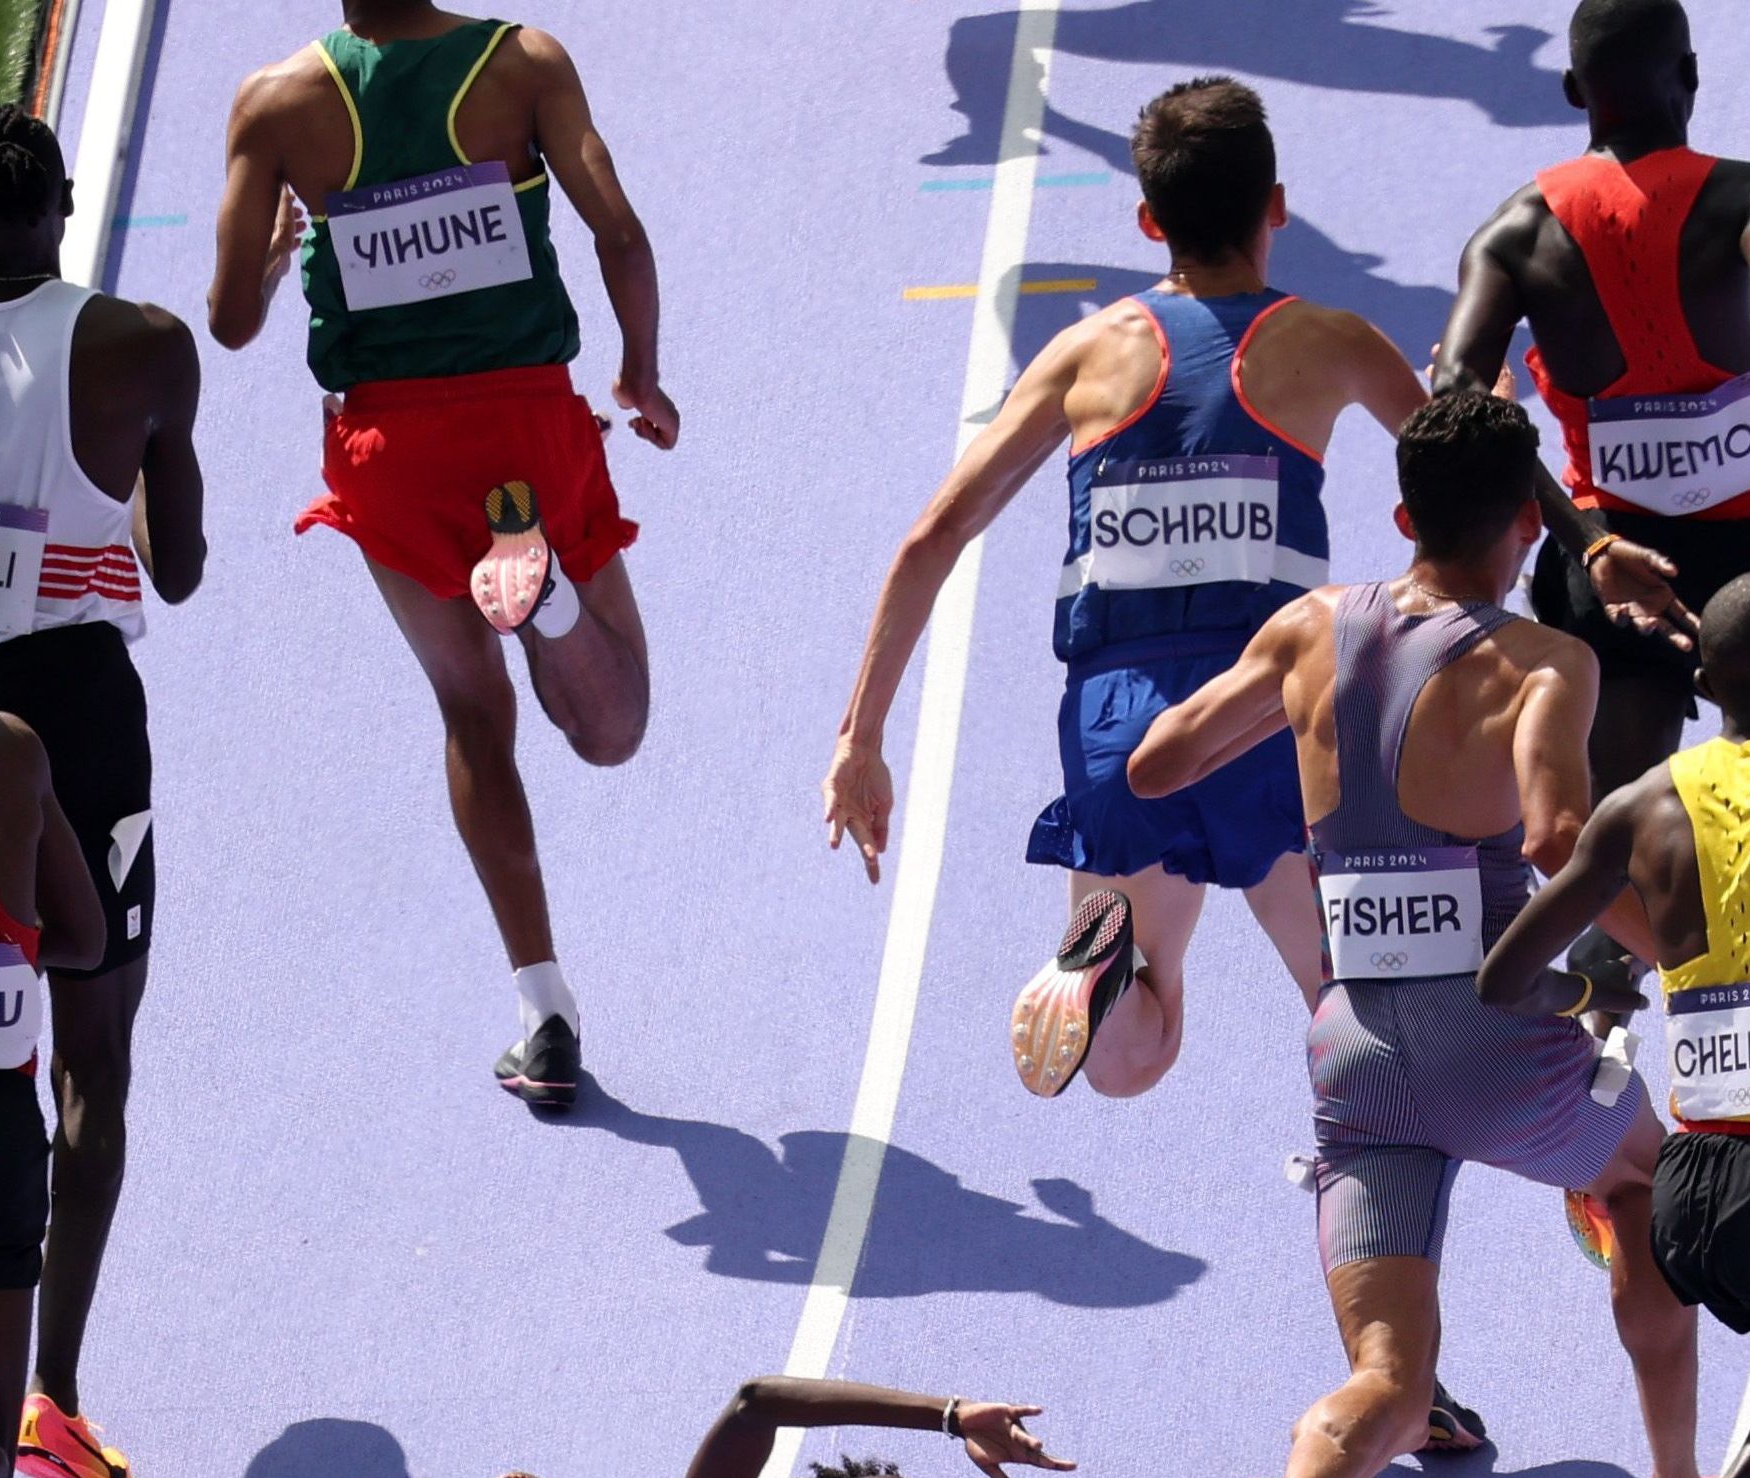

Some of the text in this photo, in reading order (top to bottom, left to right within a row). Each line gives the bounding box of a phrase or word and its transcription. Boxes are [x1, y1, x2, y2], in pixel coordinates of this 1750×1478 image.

[373, 175, 463, 203] PARIS 2024
[353, 205, 507, 269] YIHUNE
[1634, 399, 1718, 414] PARIS 2024
[1137, 462, 1230, 478] PARIS 2024
[1094, 501, 1273, 549] SCHRUB
[1344, 854, 1428, 868] PARIS 2024
[1328, 894, 1462, 938] FISHER
[1700, 990, 1739, 1005] PARIS
